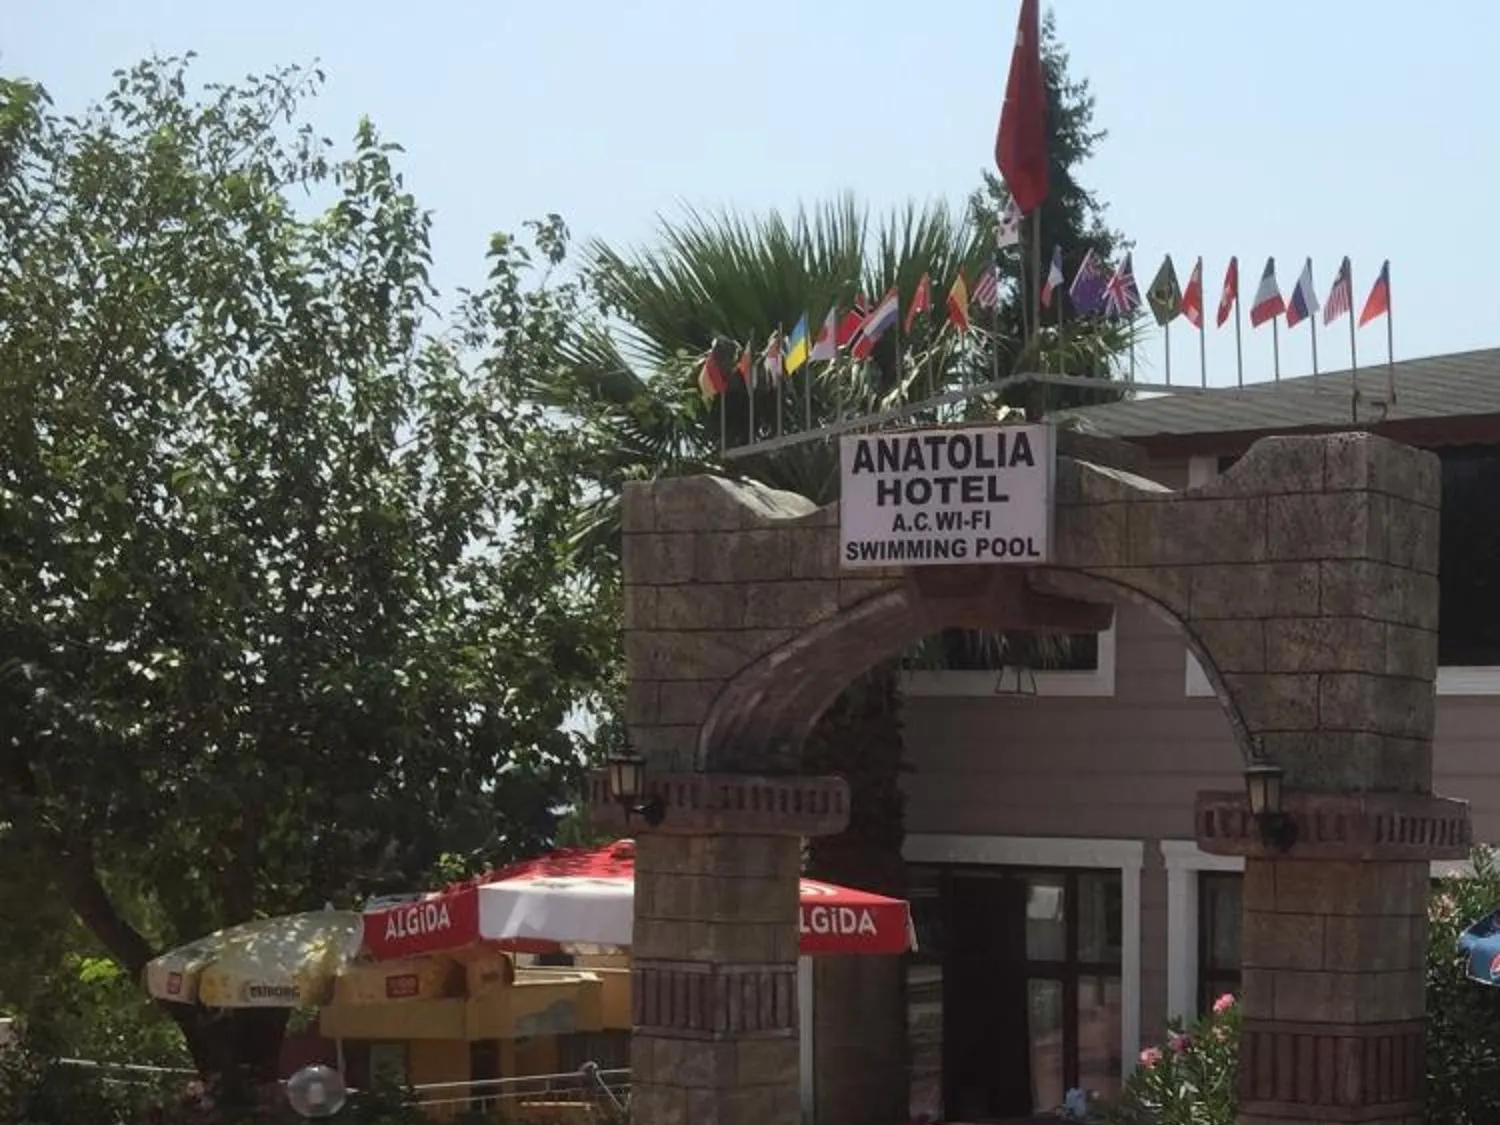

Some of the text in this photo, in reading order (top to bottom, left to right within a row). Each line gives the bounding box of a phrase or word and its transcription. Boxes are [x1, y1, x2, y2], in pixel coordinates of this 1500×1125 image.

[852, 431, 1035, 474] ANATOLIA
[876, 475, 1009, 506] HOTEL
[892, 510, 991, 532] A.C. WI-FI
[846, 537, 1040, 561] SWIMMING POOL
